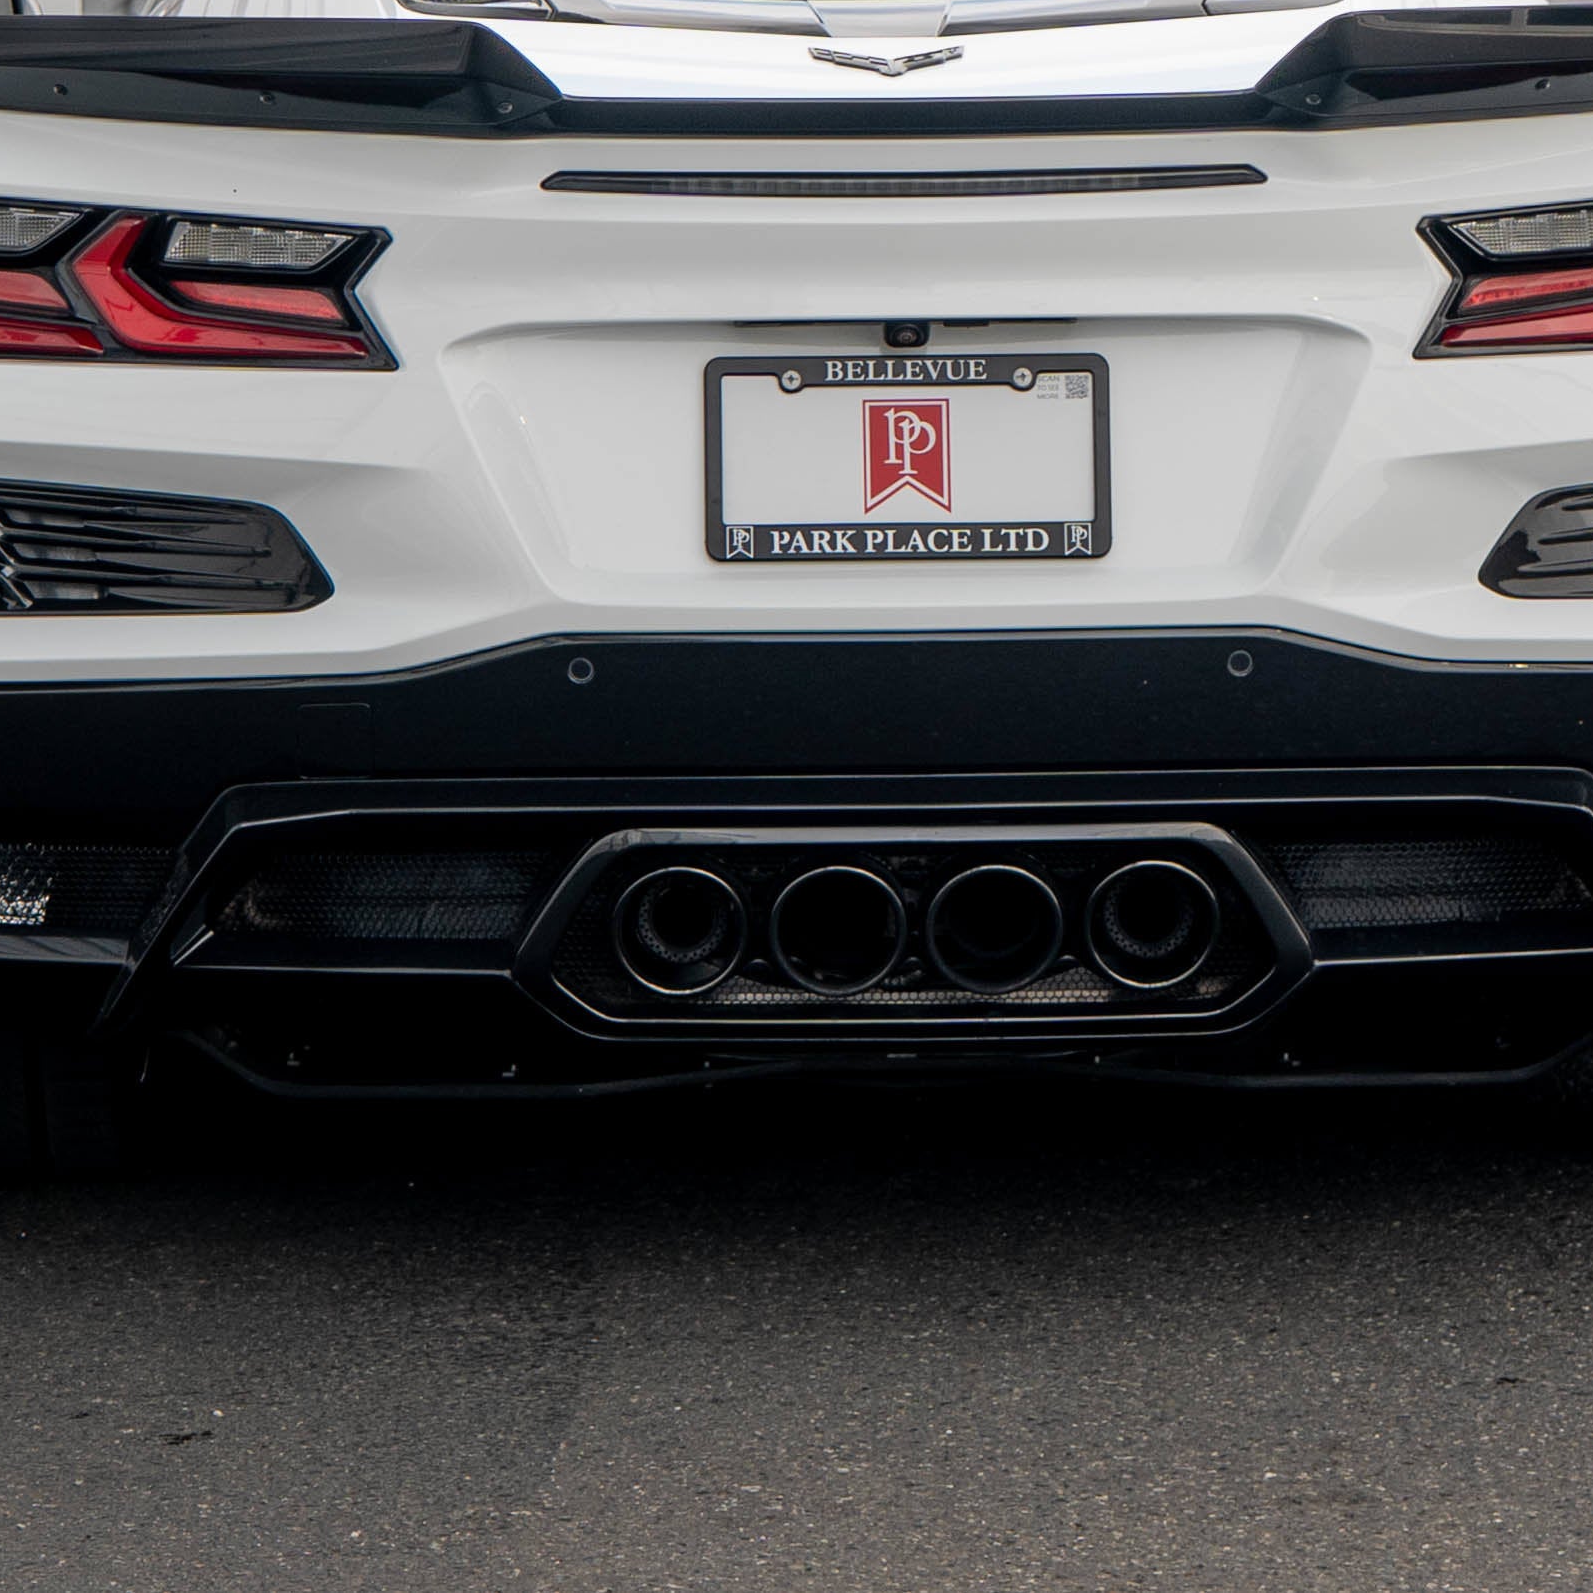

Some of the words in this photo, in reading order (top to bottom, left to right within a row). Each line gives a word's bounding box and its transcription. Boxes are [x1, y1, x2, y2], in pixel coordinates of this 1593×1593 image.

[825, 359, 988, 381] BELLEVUE
[770, 529, 857, 554] PARK
[863, 528, 972, 553] PLACE
[981, 527, 1050, 552] LTD
